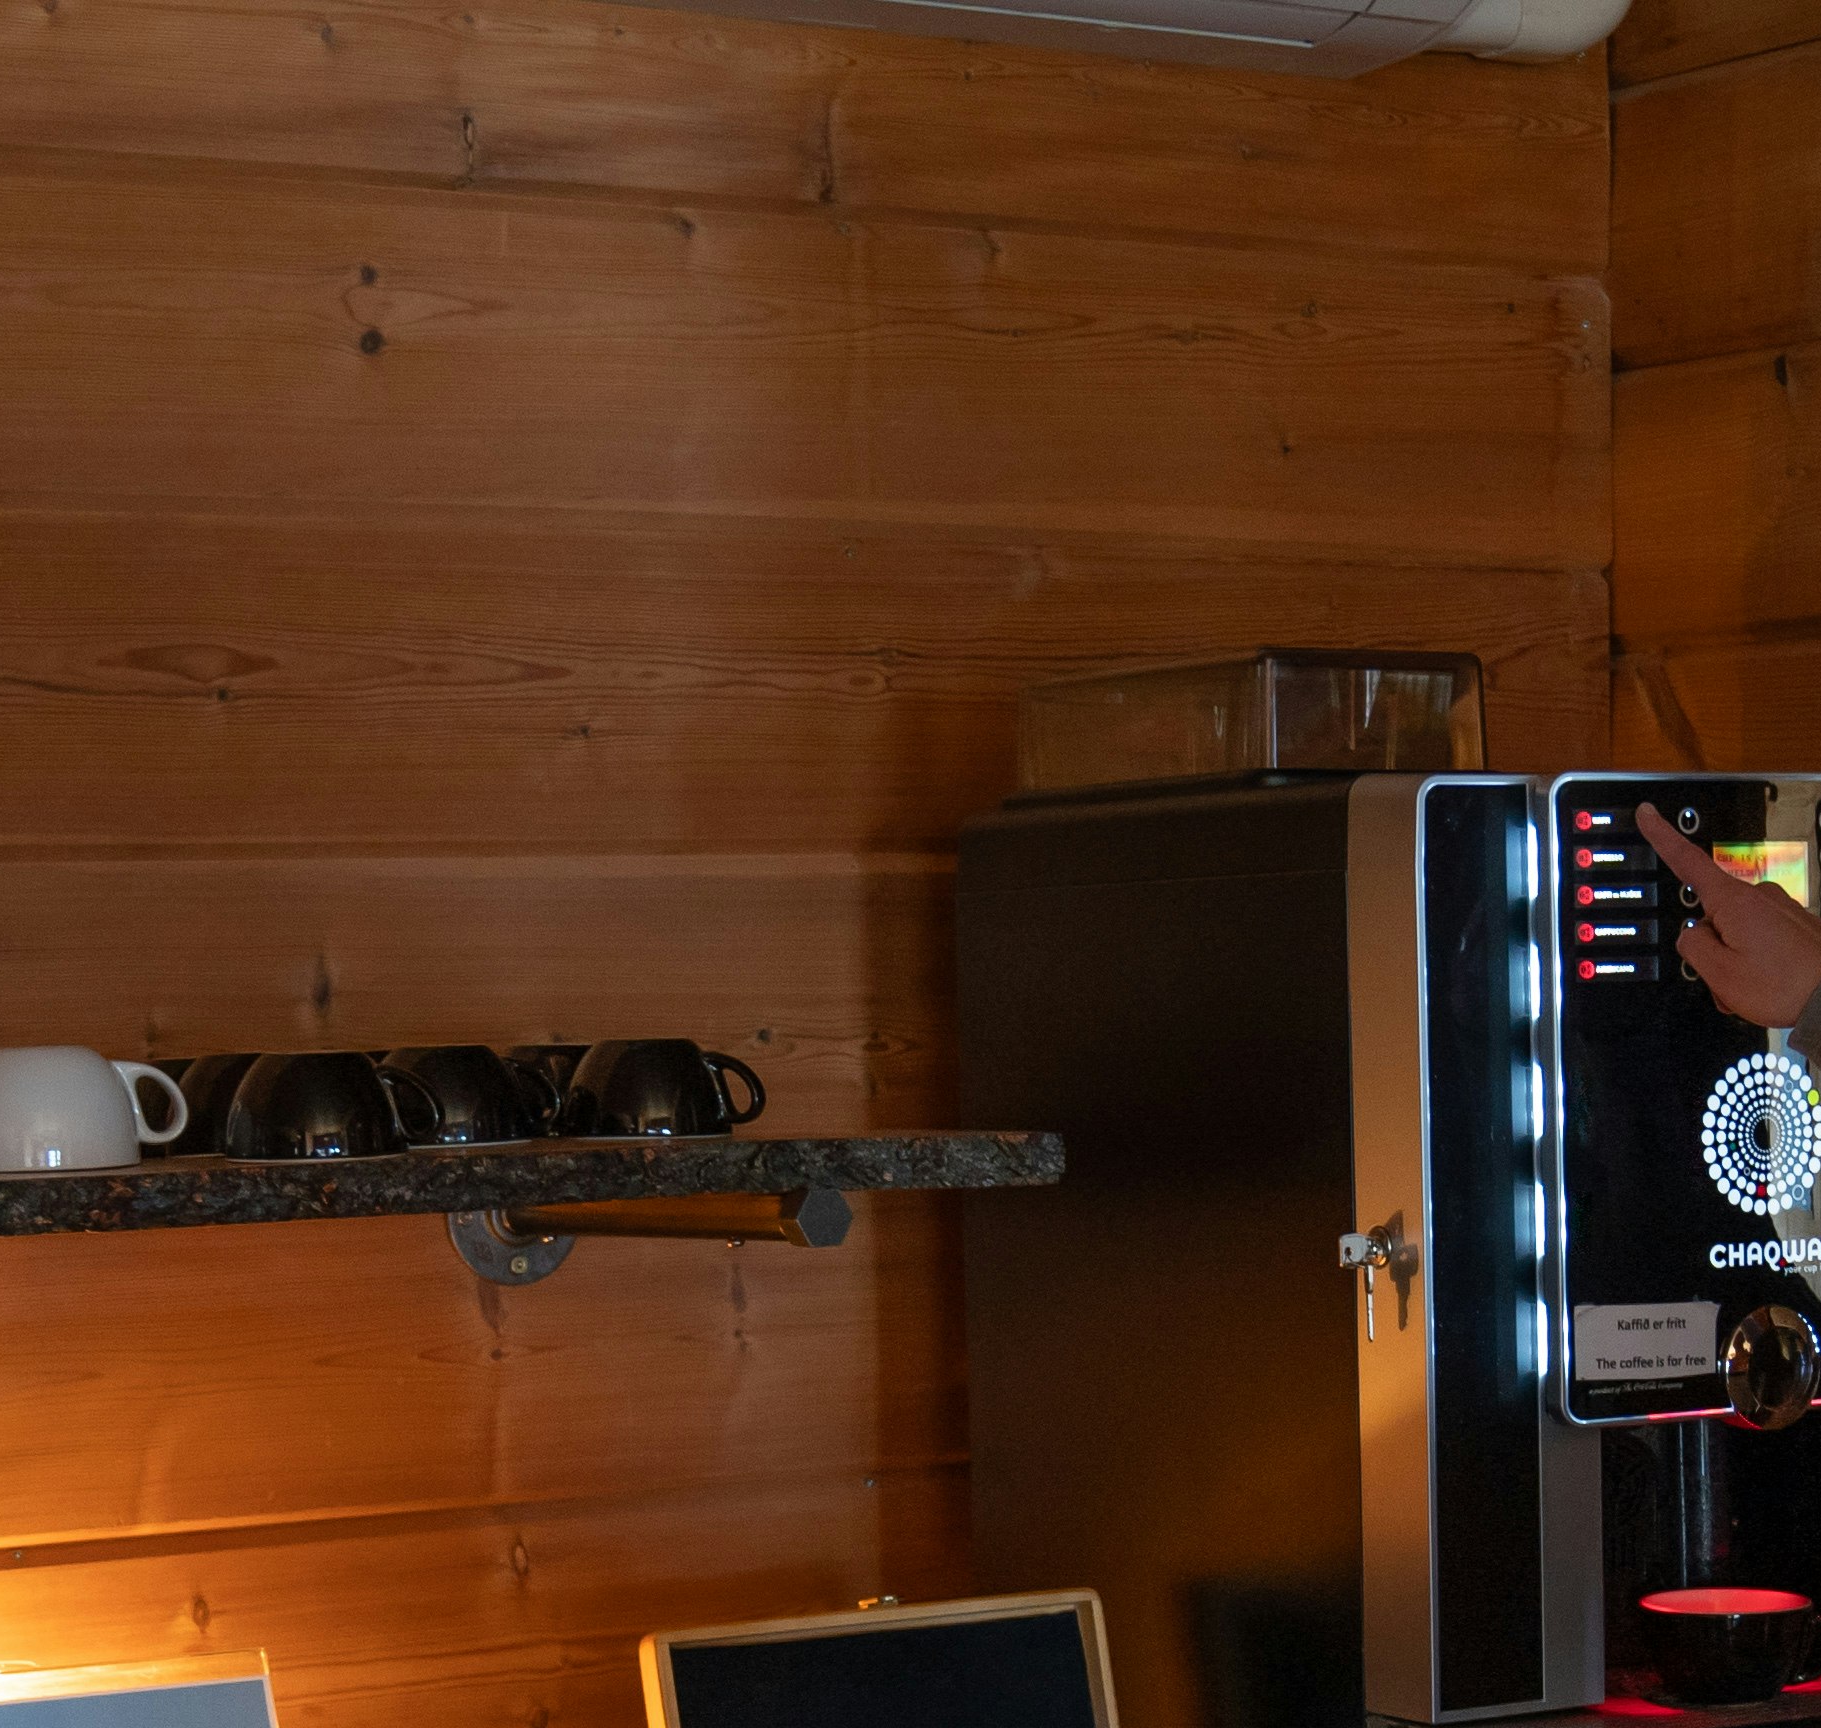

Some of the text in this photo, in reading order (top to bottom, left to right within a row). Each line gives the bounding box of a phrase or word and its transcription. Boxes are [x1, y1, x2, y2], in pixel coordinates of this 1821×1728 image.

[1617, 1319, 1650, 1331] Kaffið
[1653, 1320, 1663, 1330] er
[1596, 1354, 1707, 1370] The coffee is for free
